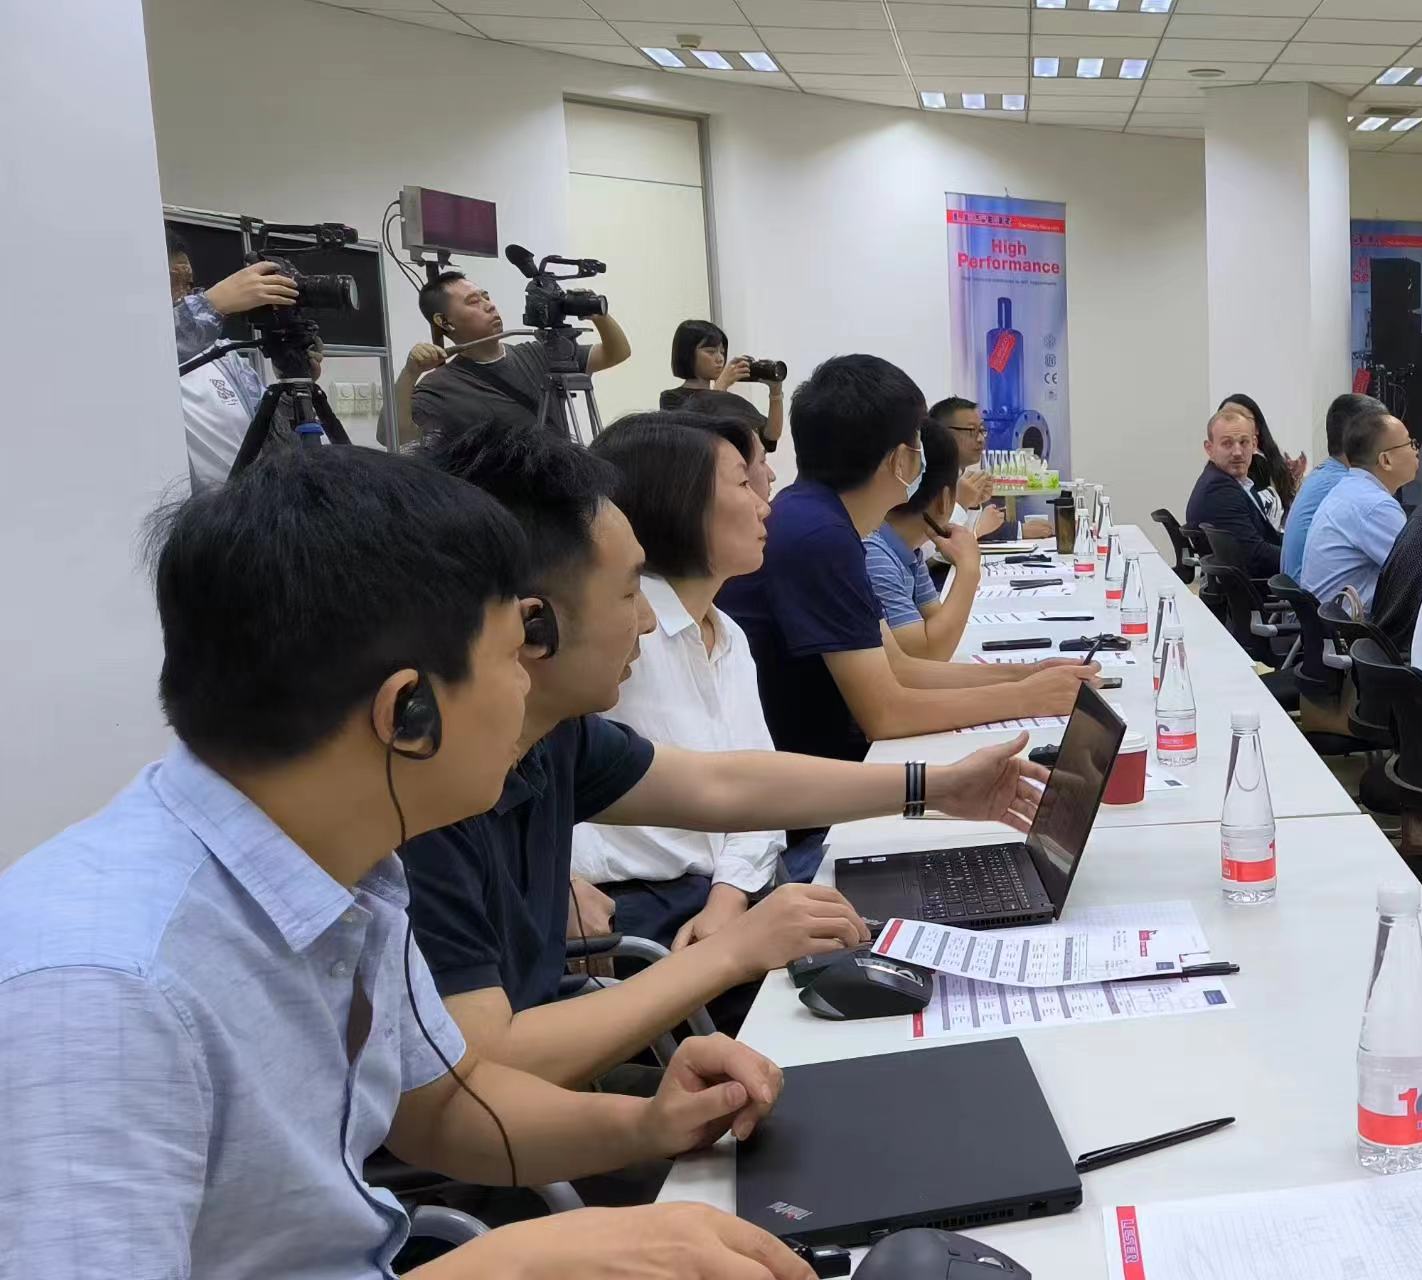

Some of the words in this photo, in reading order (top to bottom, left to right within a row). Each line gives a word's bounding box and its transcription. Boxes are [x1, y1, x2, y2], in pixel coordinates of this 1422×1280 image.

[991, 239, 1027, 258] High
[957, 252, 1060, 274] Performance
[1120, 1219, 1139, 1263] LESER
